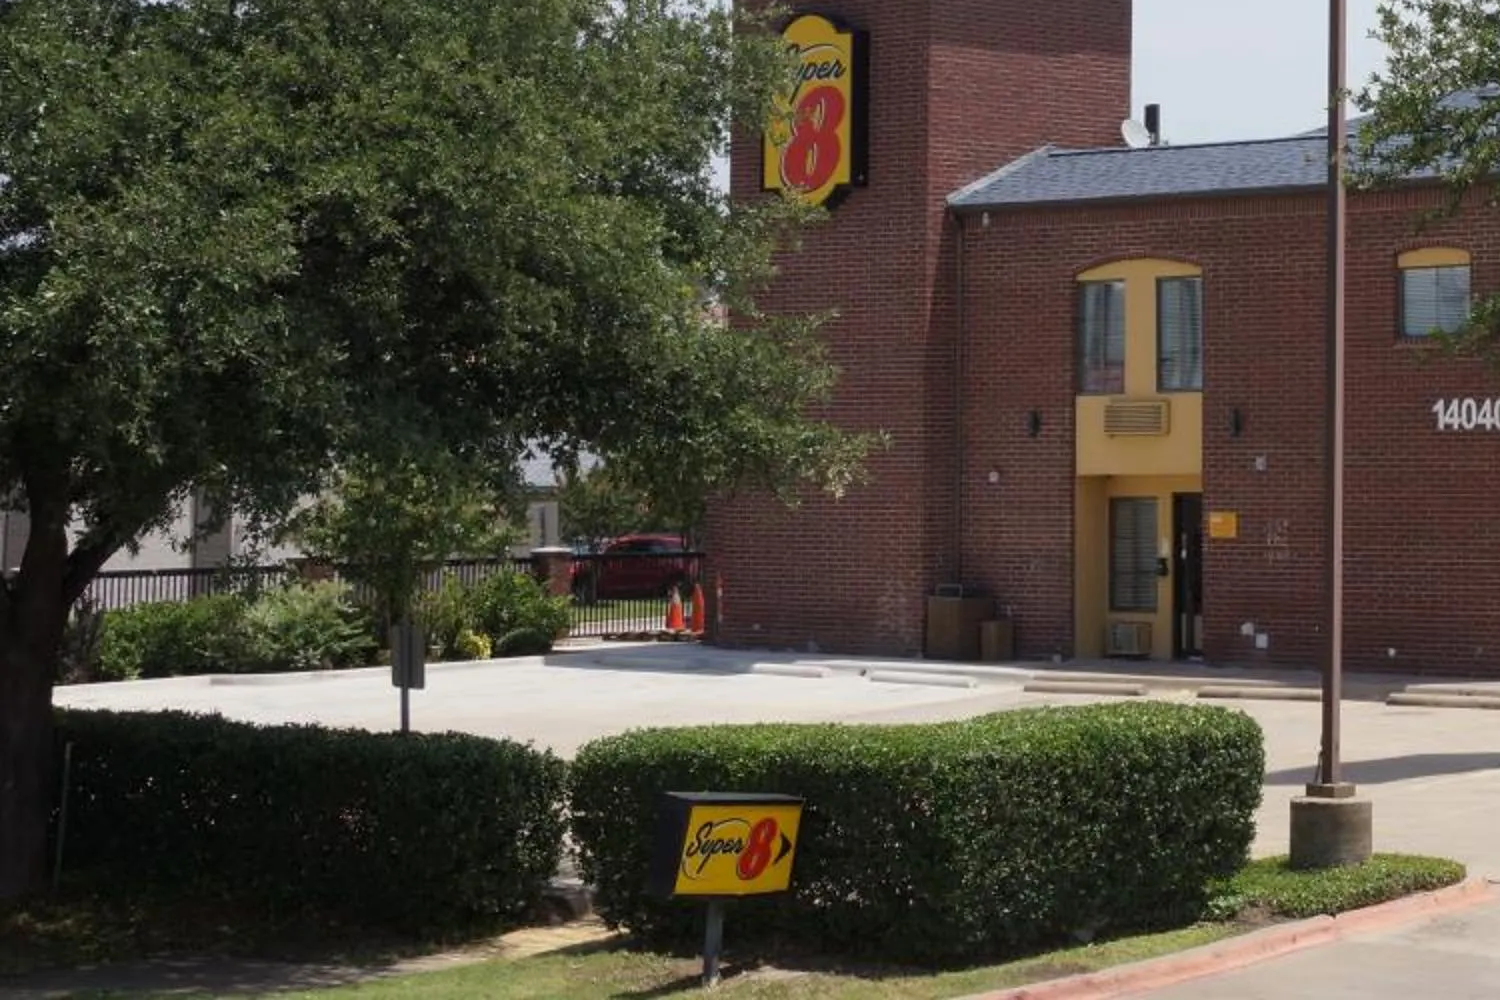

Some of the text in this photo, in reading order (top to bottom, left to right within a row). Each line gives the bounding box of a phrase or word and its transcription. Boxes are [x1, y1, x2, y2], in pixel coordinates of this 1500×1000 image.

[775, 43, 846, 105] per
[779, 85, 846, 193] 8
[686, 816, 778, 881] Super 8
